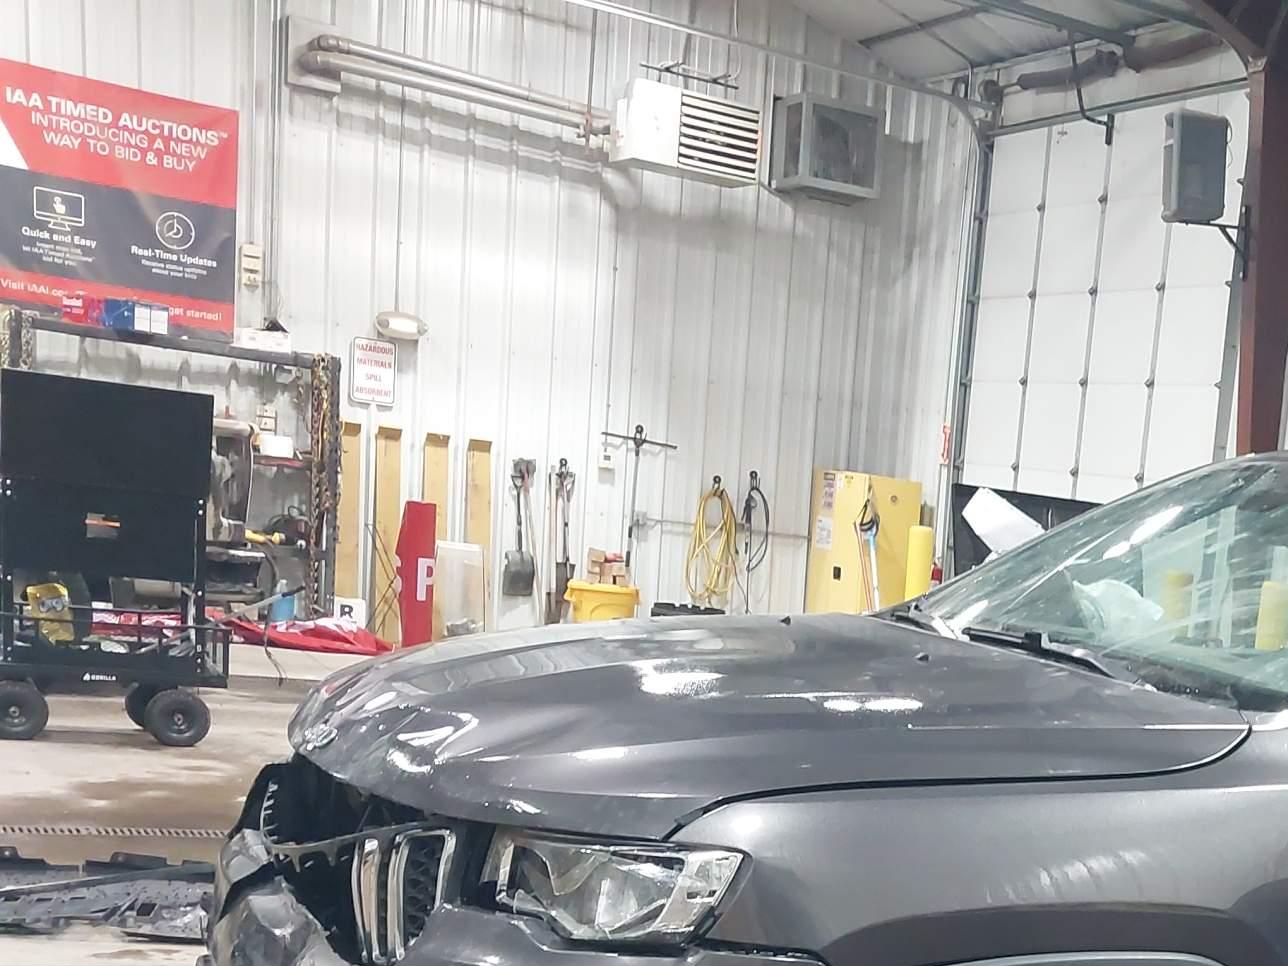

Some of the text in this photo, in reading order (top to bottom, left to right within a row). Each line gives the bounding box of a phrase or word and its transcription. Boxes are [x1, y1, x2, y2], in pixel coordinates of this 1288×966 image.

[5, 86, 44, 110] IAA
[47, 95, 113, 124] TIMED
[31, 110, 208, 160] INTRODUCING A NEW
[42, 129, 197, 173] WAY TO BID & BUY
[21, 226, 51, 240] Quick
[52, 234, 72, 244] and
[73, 235, 97, 249] Easy
[130, 245, 217, 268] Real-Time Updates
[0, 278, 25, 292] Visit
[185, 309, 223, 322] started!
[354, 341, 394, 357] HAZARDOUS
[356, 356, 393, 370] MATERIALS
[365, 372, 383, 383] SPILL
